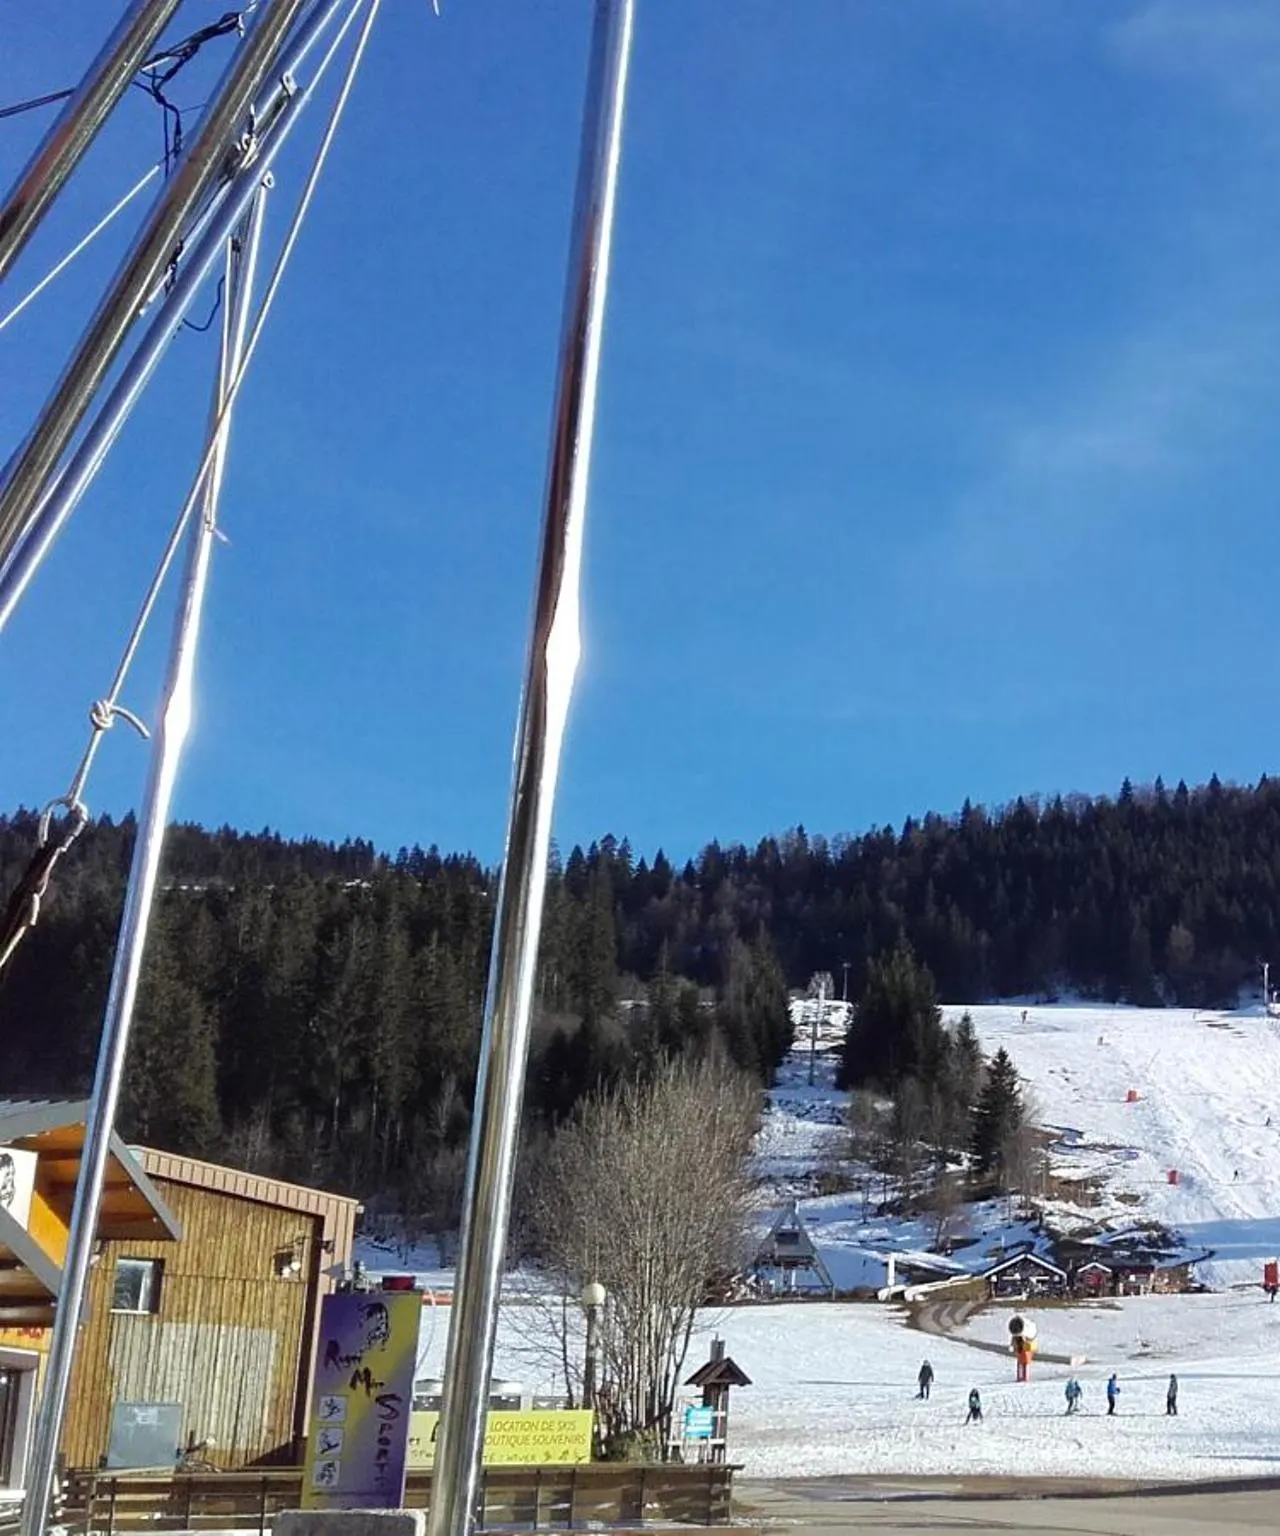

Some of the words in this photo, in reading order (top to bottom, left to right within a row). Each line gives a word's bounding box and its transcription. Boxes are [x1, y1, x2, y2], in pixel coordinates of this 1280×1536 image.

[490, 1420, 540, 1433] LOCATION
[540, 1420, 555, 1432] DE
[485, 1433, 530, 1448] OUTIQUE
[531, 1433, 587, 1446] SOUVENIRS
